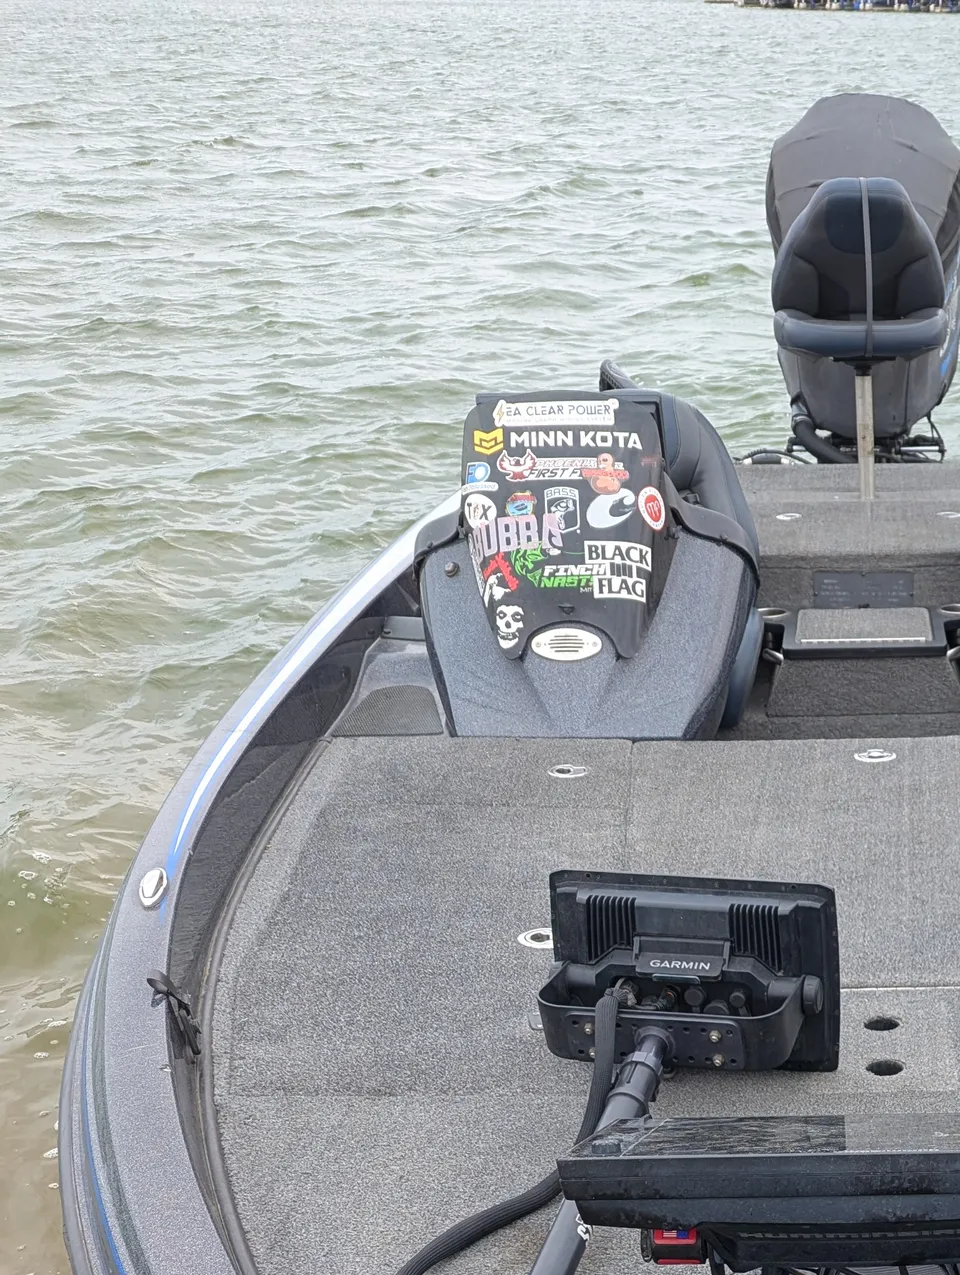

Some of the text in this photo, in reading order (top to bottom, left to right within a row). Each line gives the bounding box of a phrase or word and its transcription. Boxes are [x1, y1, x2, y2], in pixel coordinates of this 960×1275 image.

[506, 404, 611, 417] EA CLEAR POWER
[510, 430, 643, 450] MINN KOTA
[536, 458, 597, 468] PHOENIX
[528, 467, 569, 479] FIRST
[546, 488, 577, 498] BASS
[472, 513, 563, 564] BUBBA
[587, 544, 650, 568] BLACK
[543, 564, 607, 576] FINCH
[598, 577, 645, 598] FLAG
[649, 959, 711, 971] GARMIN
